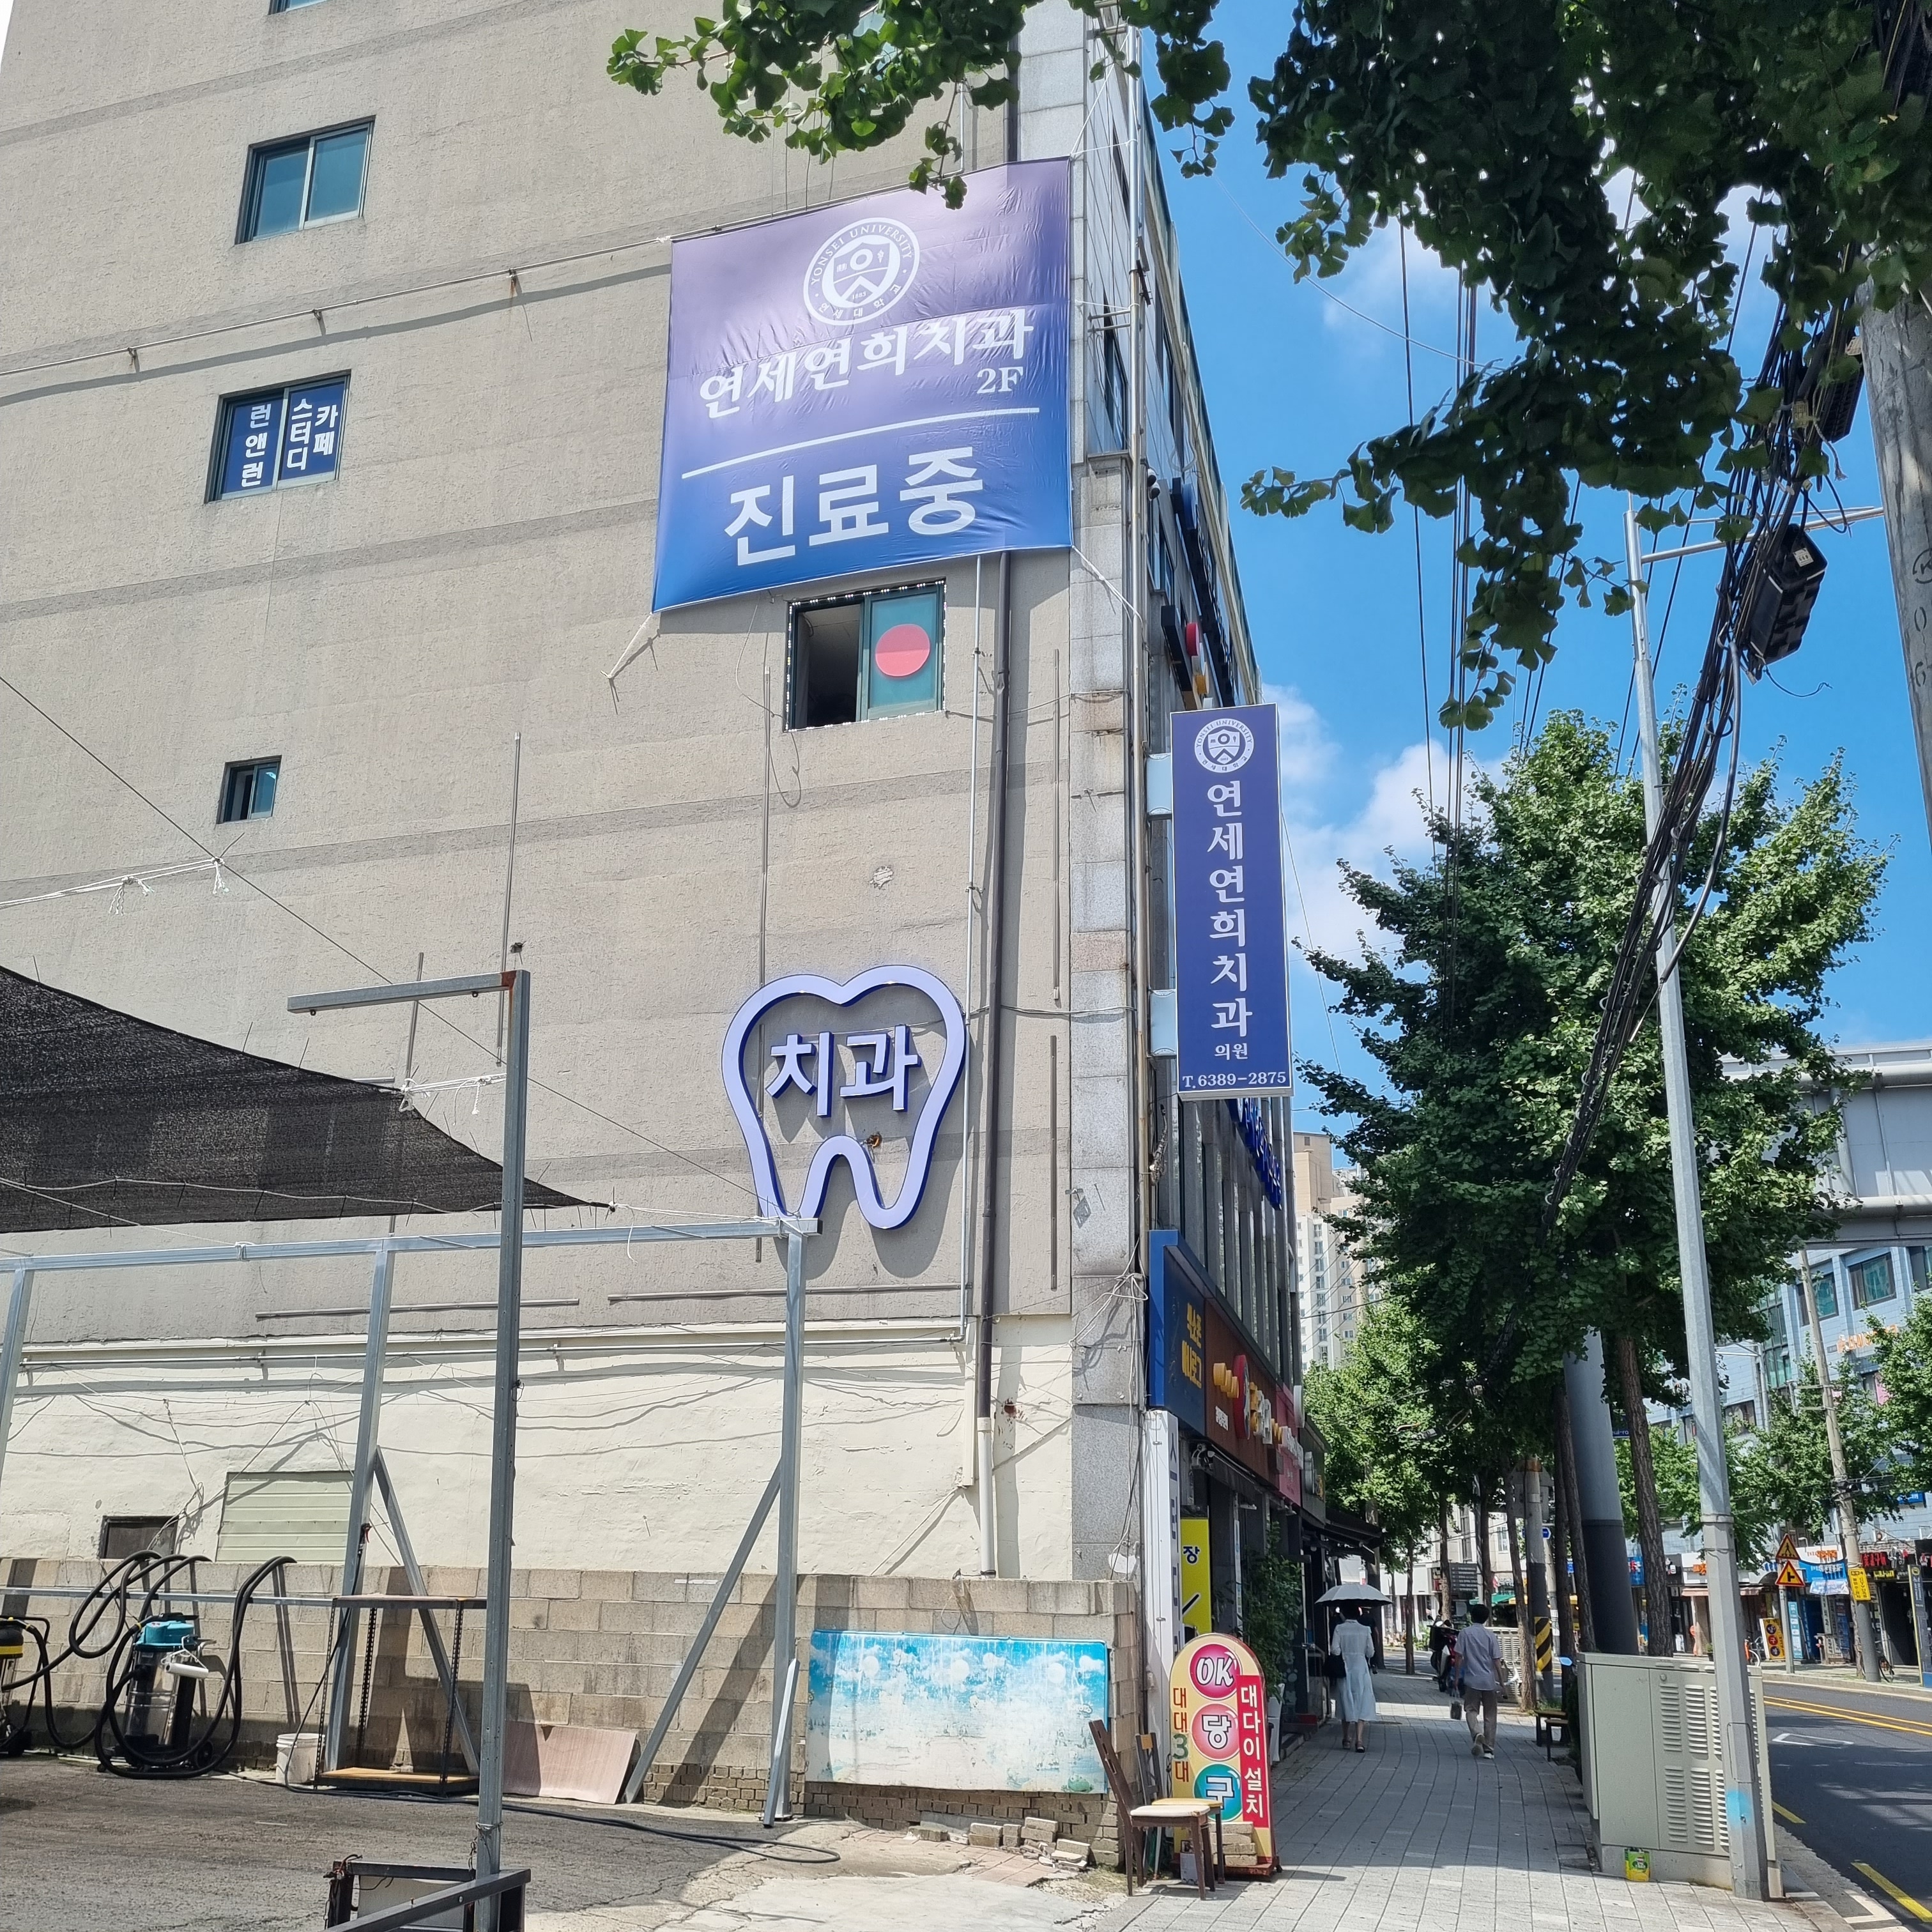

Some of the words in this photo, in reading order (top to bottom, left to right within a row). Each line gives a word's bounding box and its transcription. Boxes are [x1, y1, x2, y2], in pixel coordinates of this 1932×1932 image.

[811, 238, 845, 286] YONSEI
[849, 224, 912, 259] UNIVERSITY
[700, 309, 1034, 419] 연세연희치과
[977, 366, 1023, 395] 2F
[241, 403, 272, 487] 런앤런
[286, 398, 313, 471] 스터디
[312, 404, 339, 456] 카페
[724, 446, 984, 566] 진료중
[1196, 724, 1214, 747] YONSEI
[1216, 720, 1253, 743] UNIVERSITY
[1207, 780, 1253, 1037] 연세연희치과
[765, 1023, 921, 1117] 치과
[1214, 1043, 1248, 1061] 의원
[1183, 1546, 1200, 1564] 장
[1196, 1657, 1234, 1686] OK
